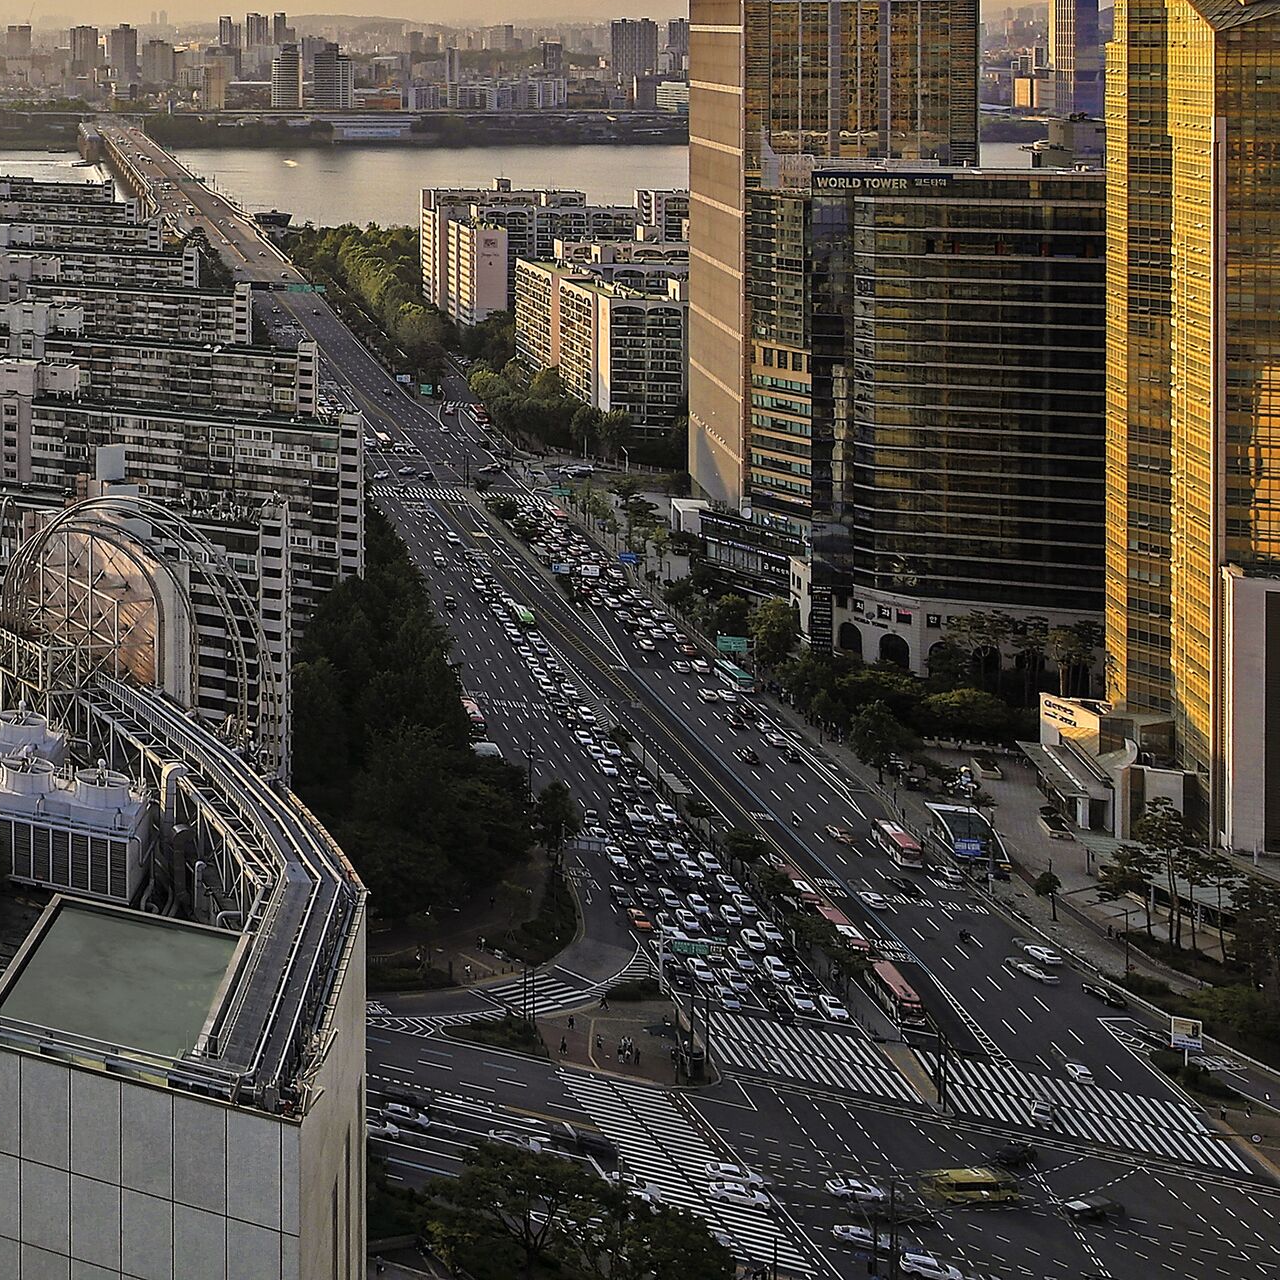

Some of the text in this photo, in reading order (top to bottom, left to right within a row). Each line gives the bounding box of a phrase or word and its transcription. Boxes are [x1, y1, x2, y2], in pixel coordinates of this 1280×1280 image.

[816, 176, 908, 190] WORLD TOWER
[910, 897, 935, 908] 50
[938, 900, 962, 912] 50
[965, 903, 990, 915] 50
